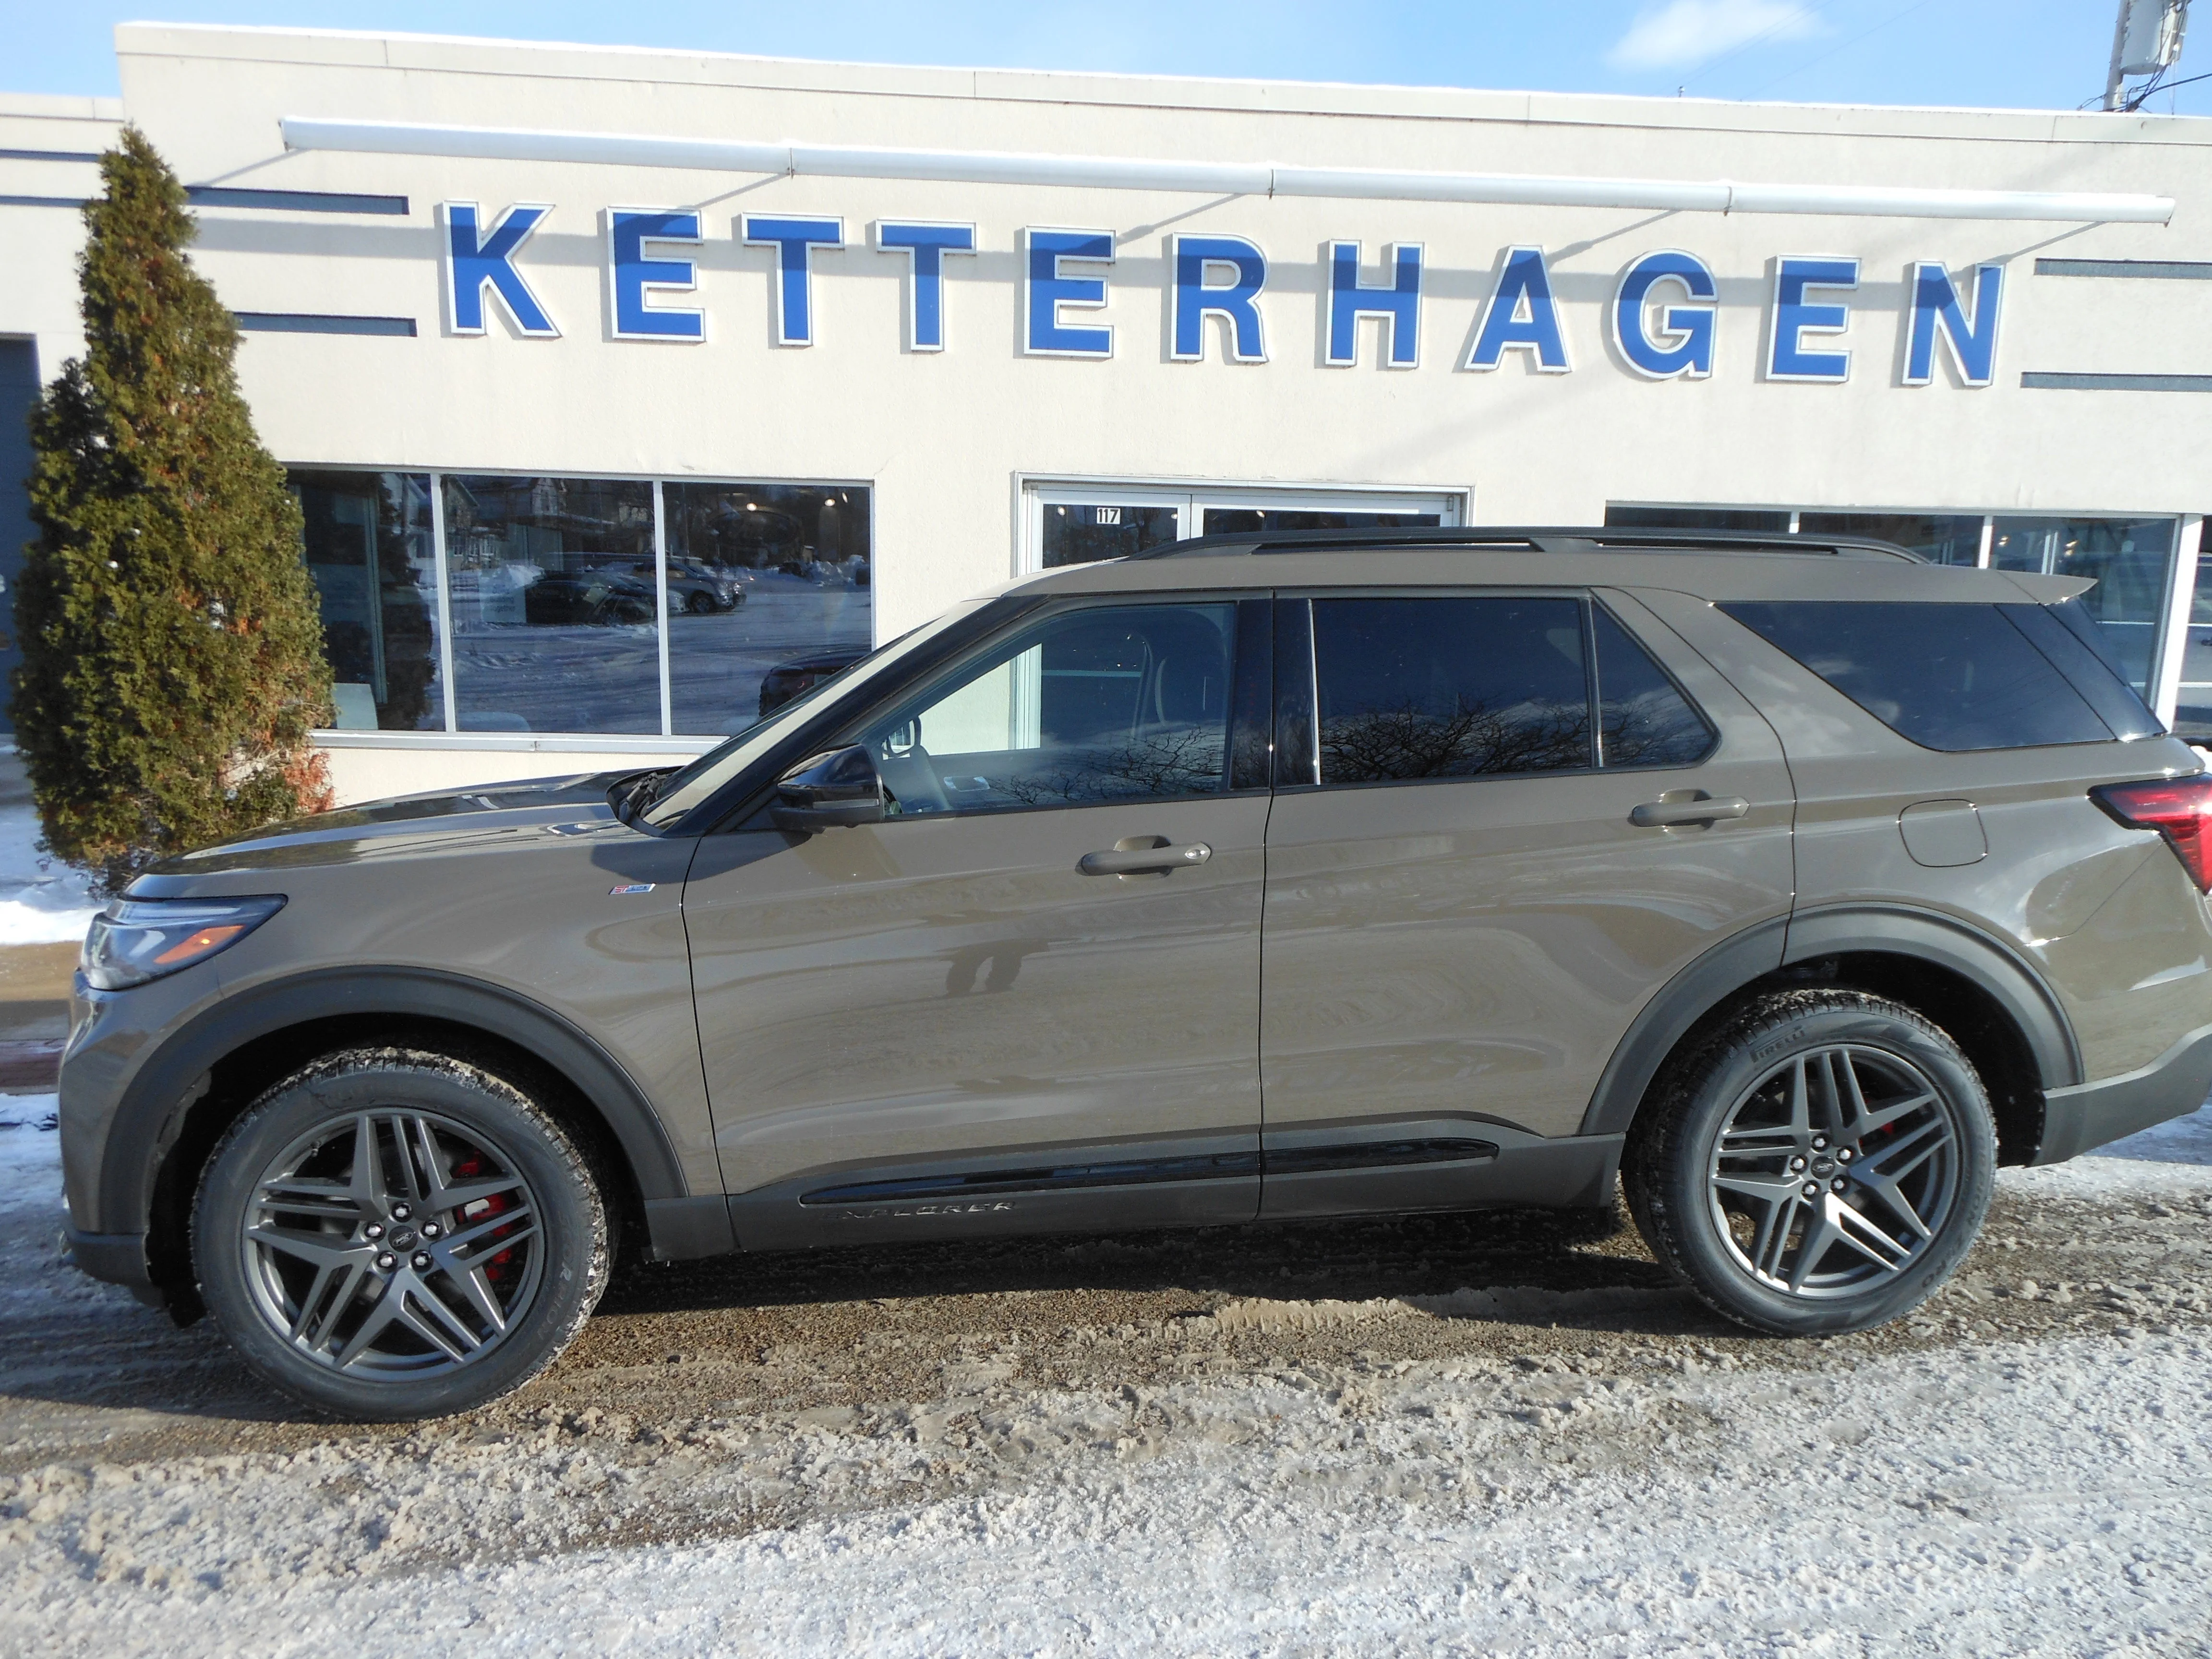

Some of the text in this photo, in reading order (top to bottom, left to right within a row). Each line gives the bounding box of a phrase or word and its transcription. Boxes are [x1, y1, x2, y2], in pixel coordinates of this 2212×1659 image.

[444, 201, 2005, 386] KETTERHAGEN
[1098, 509, 1119, 523] 117
[615, 885, 630, 893] ST
[821, 1201, 1016, 1220] XPLORER
